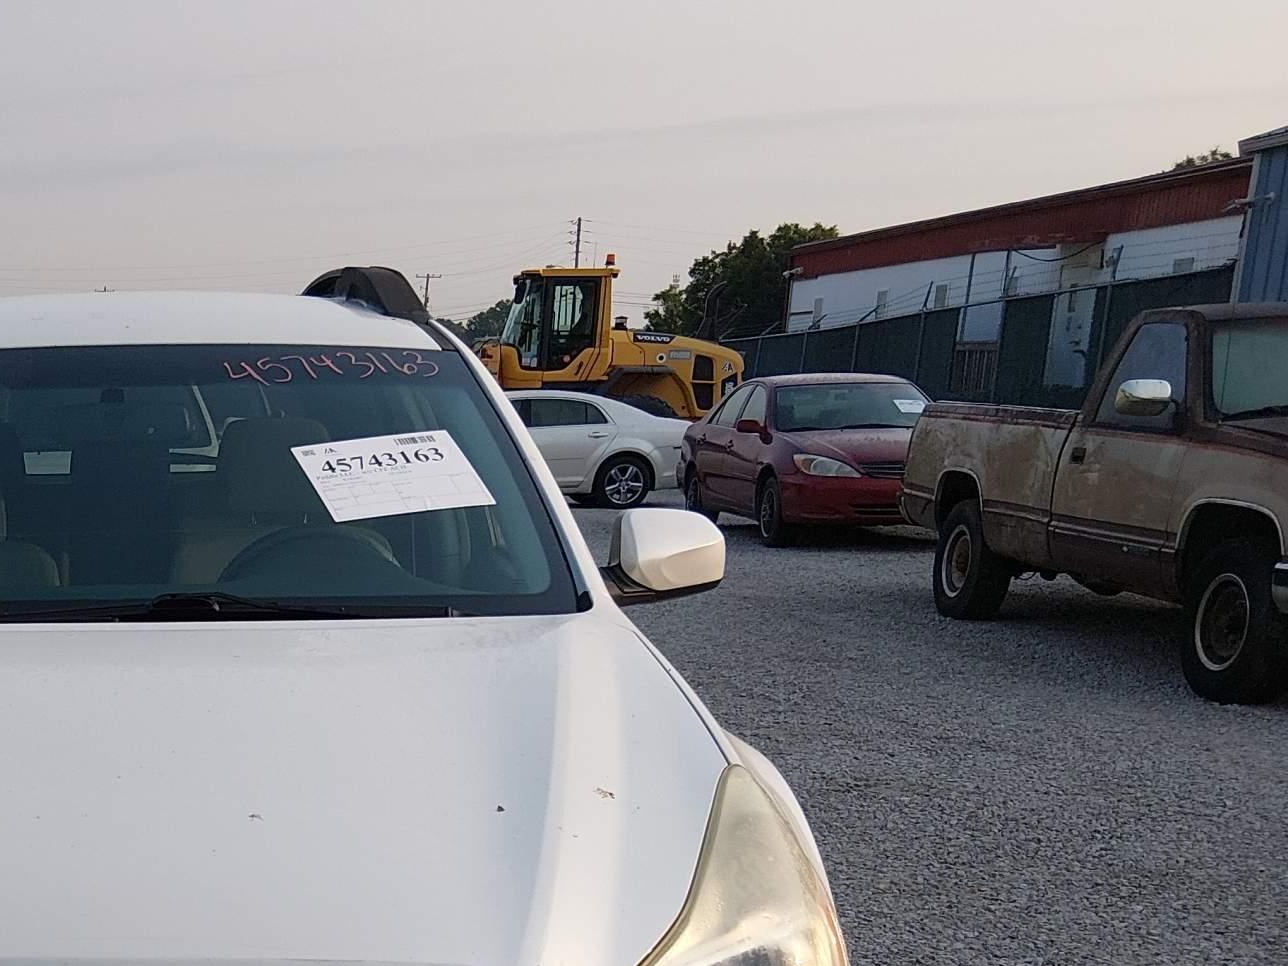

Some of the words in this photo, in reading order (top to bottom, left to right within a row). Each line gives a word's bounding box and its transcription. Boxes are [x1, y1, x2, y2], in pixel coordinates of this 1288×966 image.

[635, 334, 671, 343] VOLVO
[223, 350, 439, 386] 45743163
[321, 447, 445, 474] 45743163
